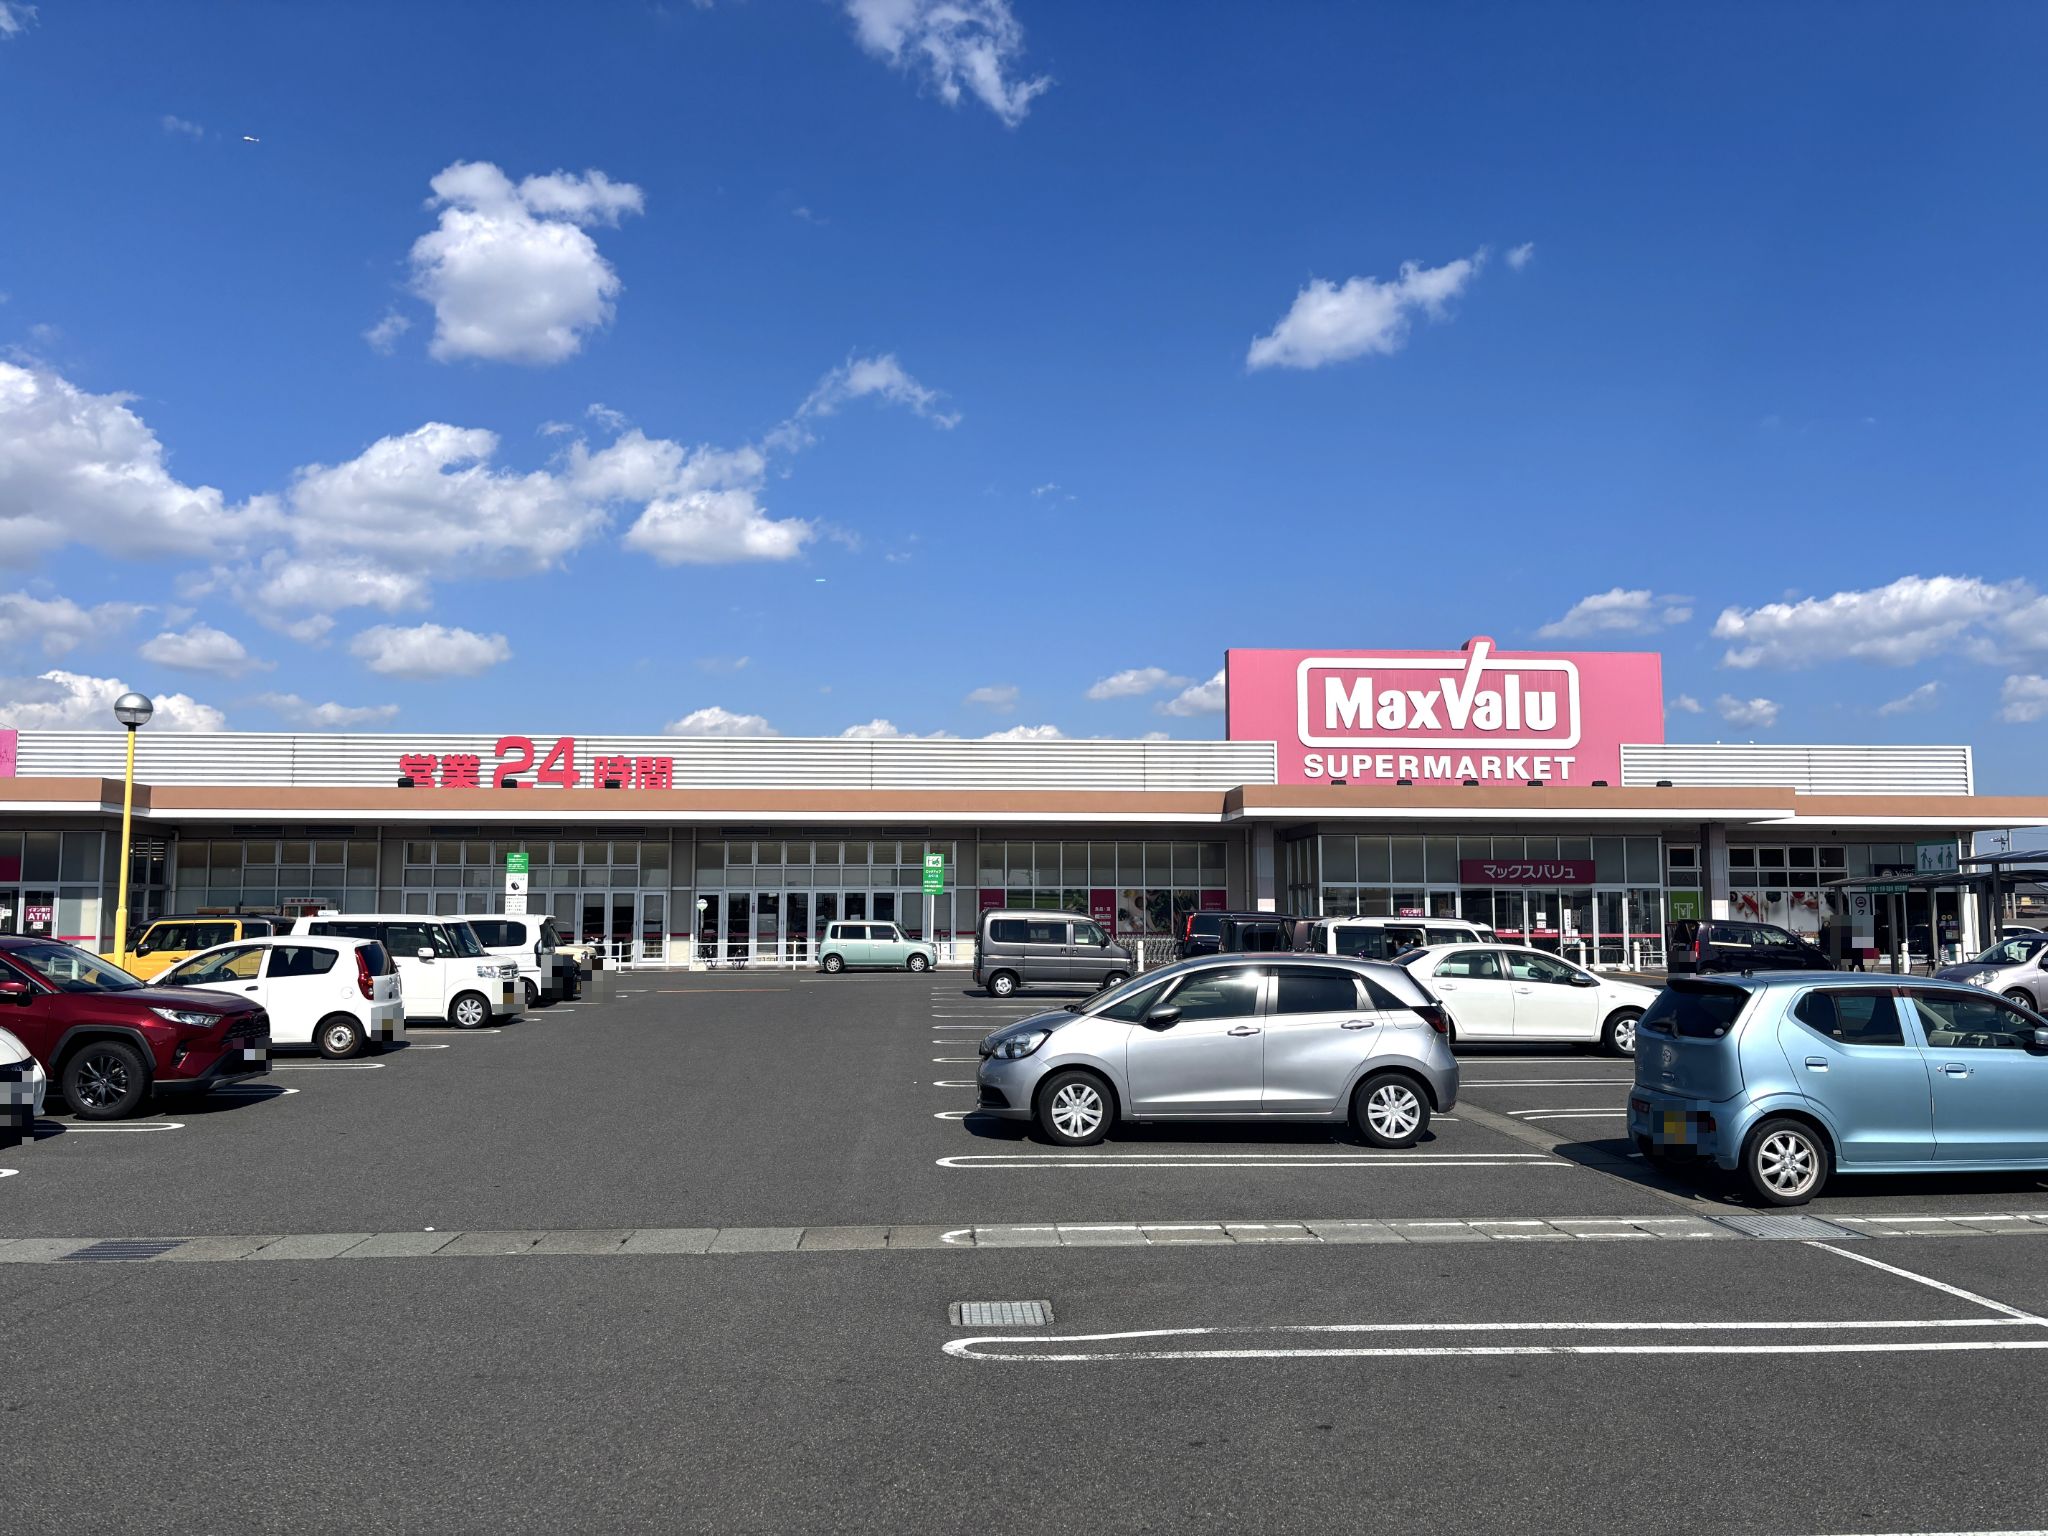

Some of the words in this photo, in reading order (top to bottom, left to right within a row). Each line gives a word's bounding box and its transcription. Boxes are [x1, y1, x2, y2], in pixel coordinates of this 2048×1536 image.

[1324, 641, 1558, 731] MaxValu
[1303, 754, 1576, 780] SUPERMARKET
[1483, 864, 1576, 879] マックスバリュ
[28, 912, 51, 921] ATM
